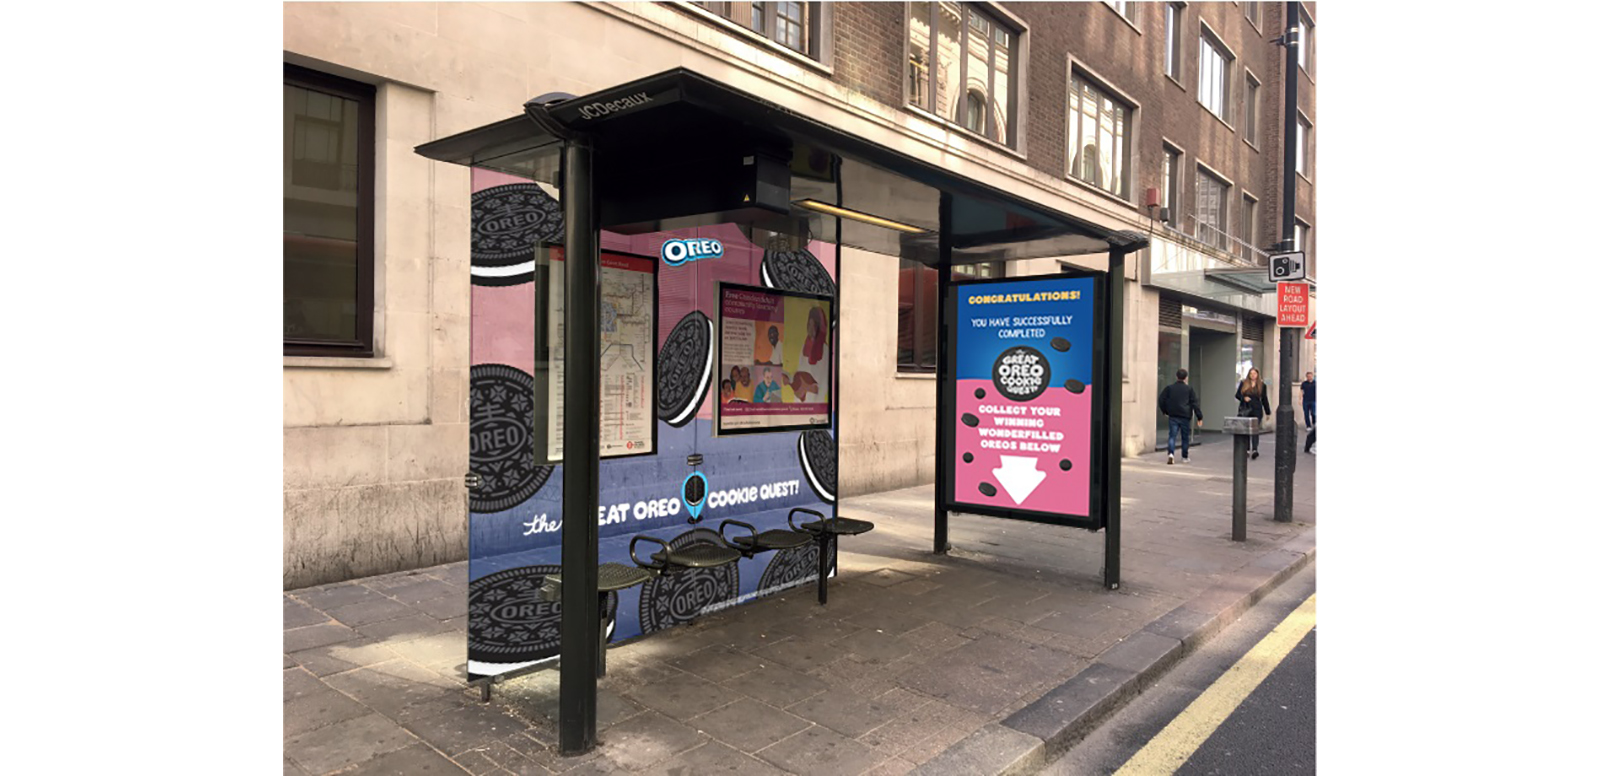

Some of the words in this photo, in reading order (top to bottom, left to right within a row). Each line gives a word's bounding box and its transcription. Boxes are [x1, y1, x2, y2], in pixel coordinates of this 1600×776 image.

[578, 92, 653, 120] JCDecaux
[485, 212, 539, 232] OREO
[664, 240, 722, 262] OREO
[1284, 286, 1301, 294] NEW
[968, 291, 1080, 304] CONGRATULATIONS!
[1283, 294, 1303, 303] ROAD
[1279, 304, 1306, 313] LAYOUT
[971, 318, 987, 327] YOU
[989, 317, 1010, 327] HAVE
[1013, 315, 1073, 327] SUCCESSFULLY
[1281, 313, 1305, 322] AHEAD
[998, 328, 1046, 338] COMPLETED
[1002, 355, 1039, 365] GREAT
[998, 364, 1044, 377] OREO
[978, 404, 1027, 415] COLLECT
[1030, 406, 1061, 417] YOUR
[993, 417, 1044, 428] WINNING
[470, 426, 519, 453] OREO
[978, 427, 1064, 441] WONDERFILLED
[980, 439, 1017, 450] OREOS
[1019, 441, 1061, 453] BELOW
[523, 513, 563, 536] the
[598, 503, 630, 526] EAT
[633, 498, 681, 520] OREO
[760, 480, 799, 500] QUEST!
[675, 581, 713, 614] OREO
